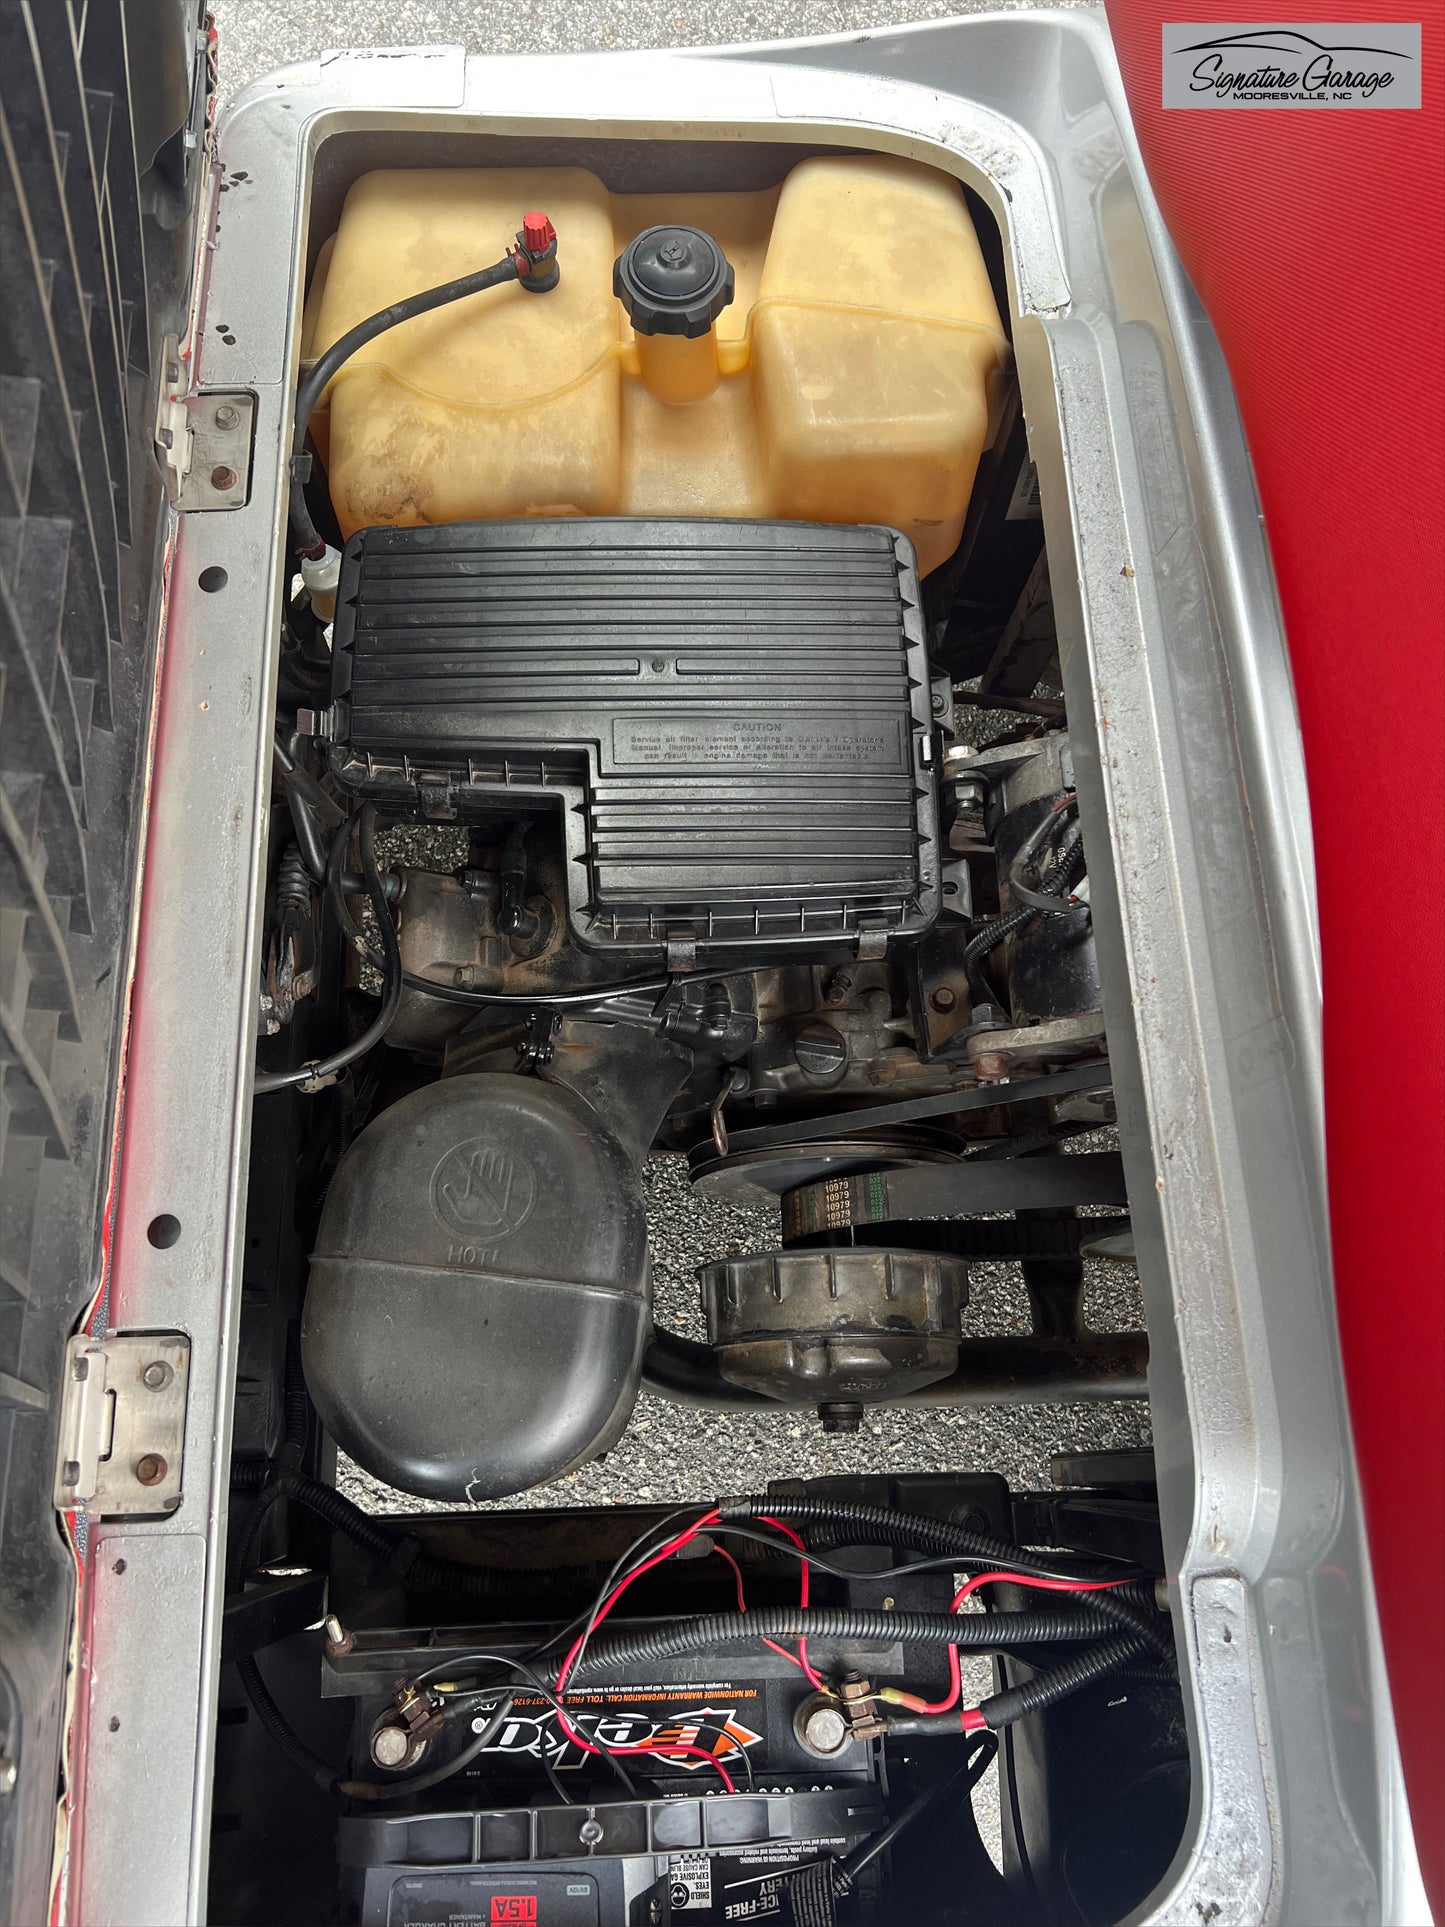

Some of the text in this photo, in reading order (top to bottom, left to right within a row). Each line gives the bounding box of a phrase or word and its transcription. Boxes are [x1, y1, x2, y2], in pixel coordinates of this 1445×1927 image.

[733, 723, 782, 731] CAUTION
[679, 735, 699, 743] filter
[668, 744, 704, 752] Improper
[856, 744, 884, 753] system
[825, 1181, 849, 1193] 10979
[826, 1190, 850, 1202] 10979
[826, 1200, 850, 1212] 10979
[826, 1209, 851, 1221] 10979
[622, 1692, 667, 1701] INFORMATION
[667, 1691, 703, 1700] WARRANTY
[704, 1690, 745, 1699] NATIONWIDE
[745, 1689, 757, 1698] FOR
[567, 1696, 585, 1704] FREE
[586, 1695, 604, 1703] TOLL
[680, 1872, 709, 1880] EXPLOSIVE
[694, 1882, 709, 1890] EYES.
[690, 1892, 710, 1900] SHIELD
[495, 1899, 533, 1917] 1.5A
